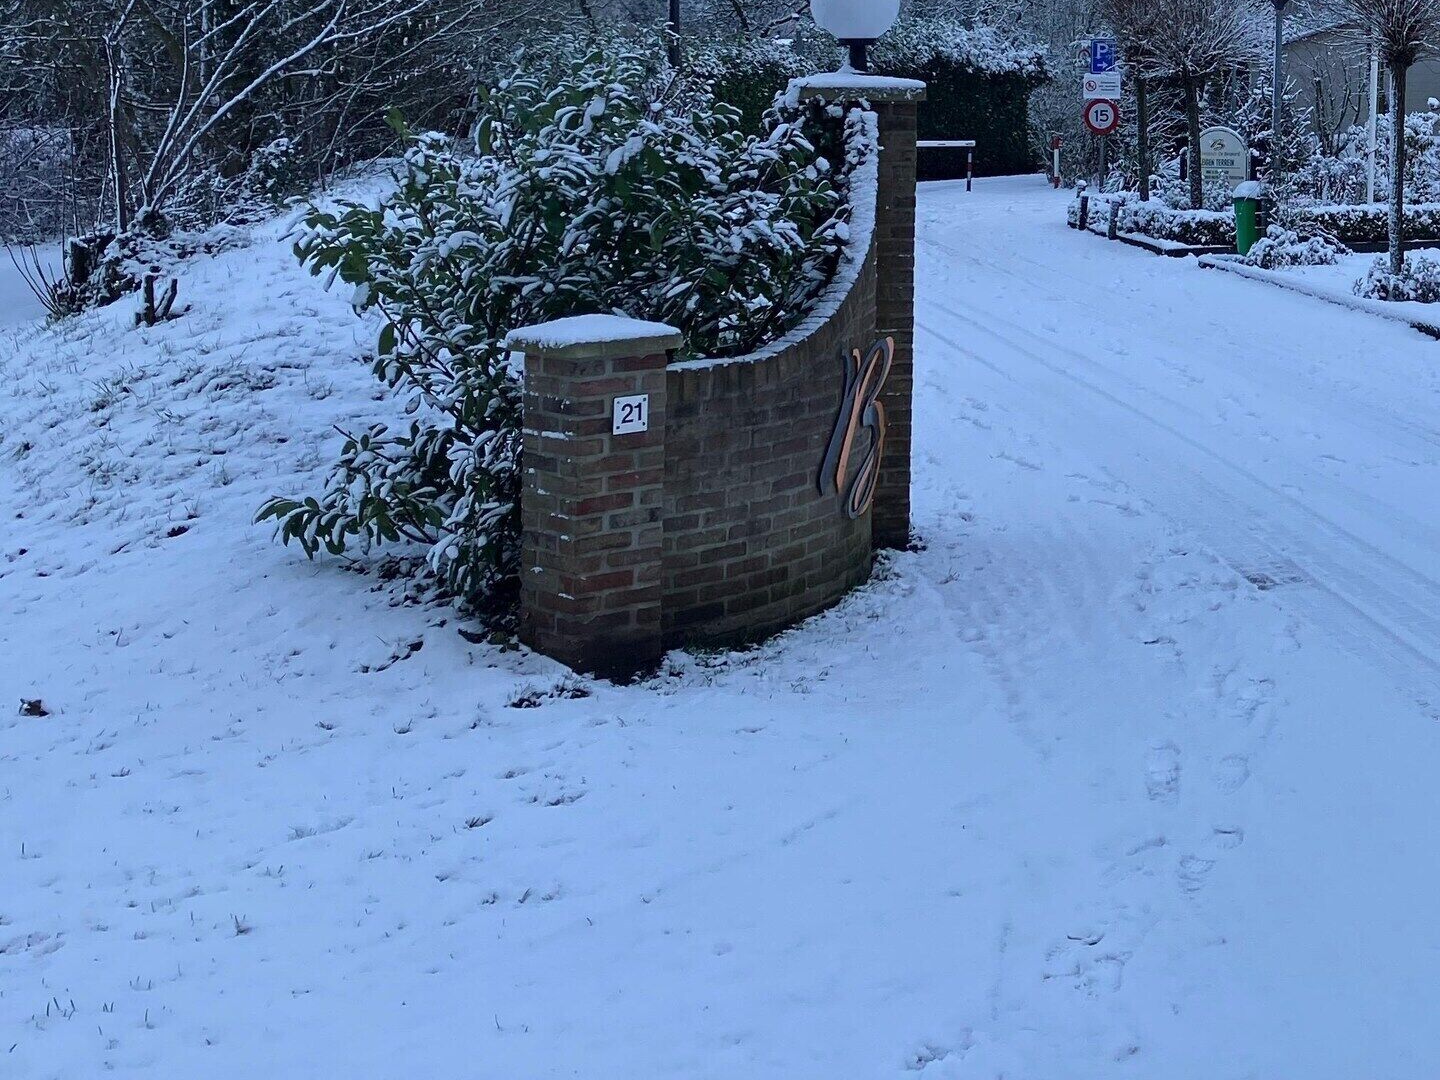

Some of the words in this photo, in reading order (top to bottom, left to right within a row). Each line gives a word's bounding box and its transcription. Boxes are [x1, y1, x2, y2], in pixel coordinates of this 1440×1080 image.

[1096, 42, 1109, 60] P
[1094, 109, 1109, 122] 15
[620, 402, 643, 425] 21
